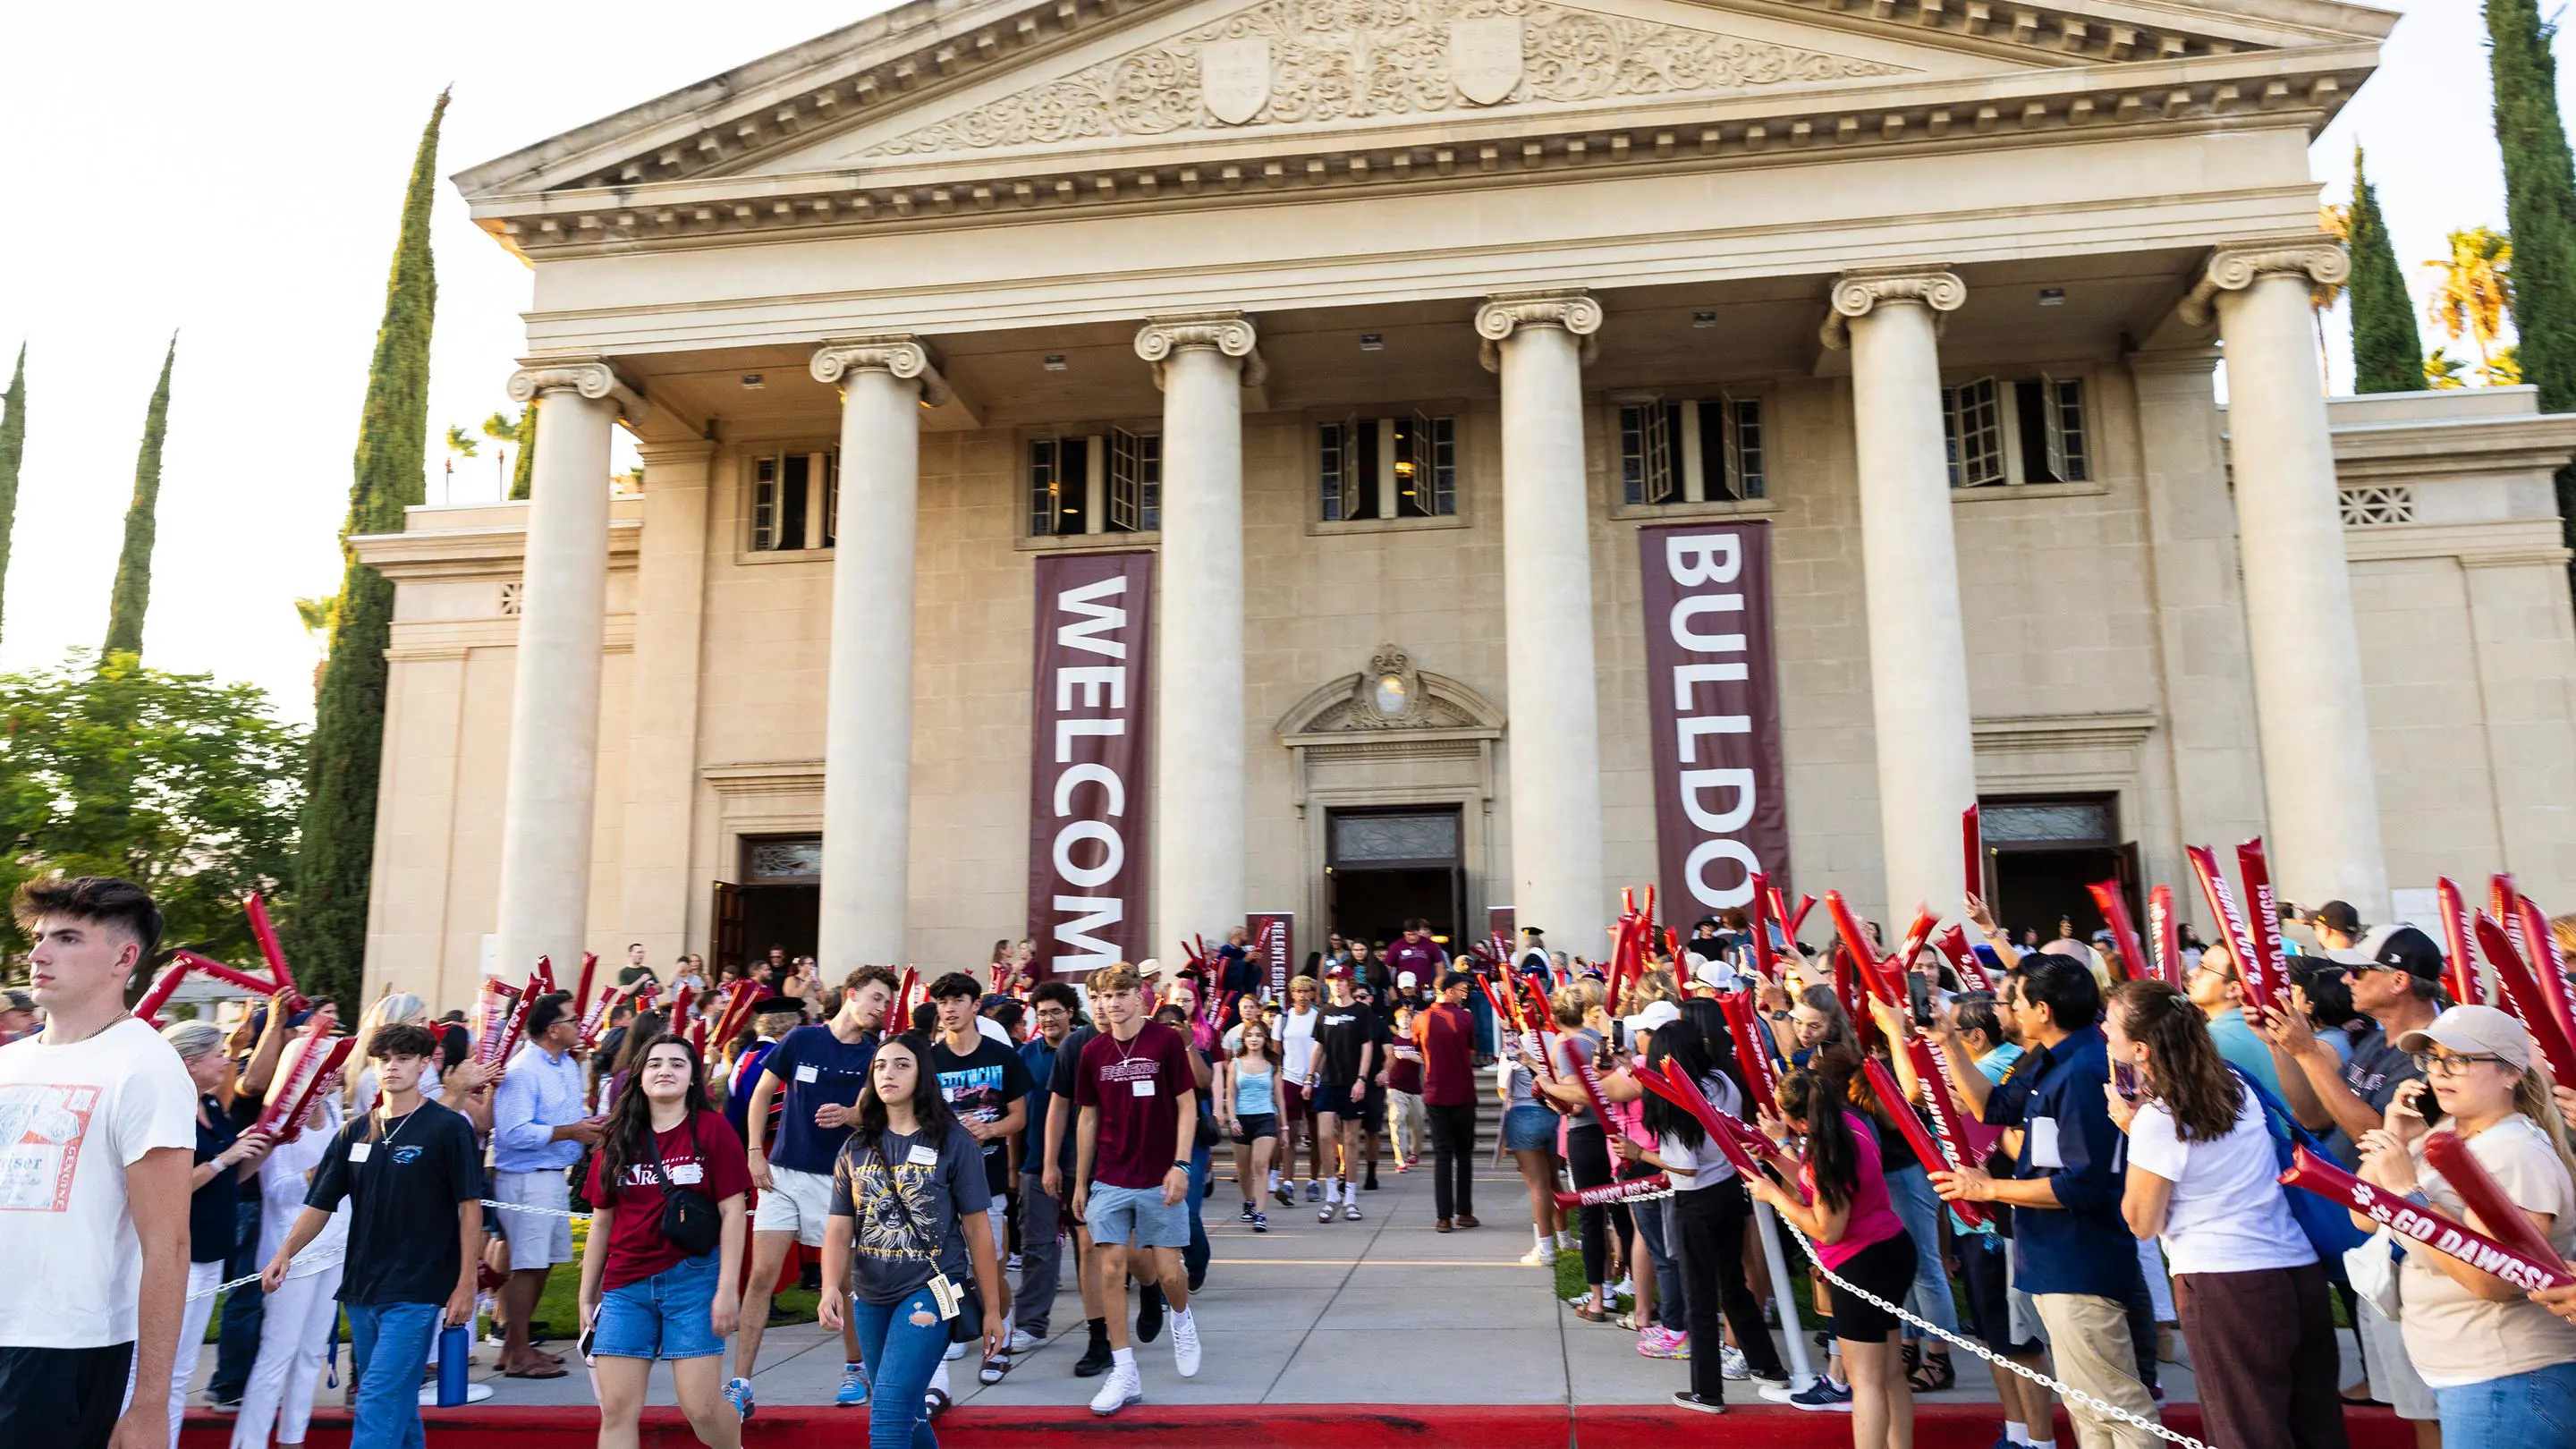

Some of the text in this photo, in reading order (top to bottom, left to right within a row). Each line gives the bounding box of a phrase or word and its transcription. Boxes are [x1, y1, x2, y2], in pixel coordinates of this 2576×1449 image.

[1048, 575, 1128, 1019] WELCOM
[1665, 533, 1762, 939] BULLDO
[55, 1145, 78, 1209] GENUINE
[2391, 1208, 2555, 1292] GO DAWGS!
